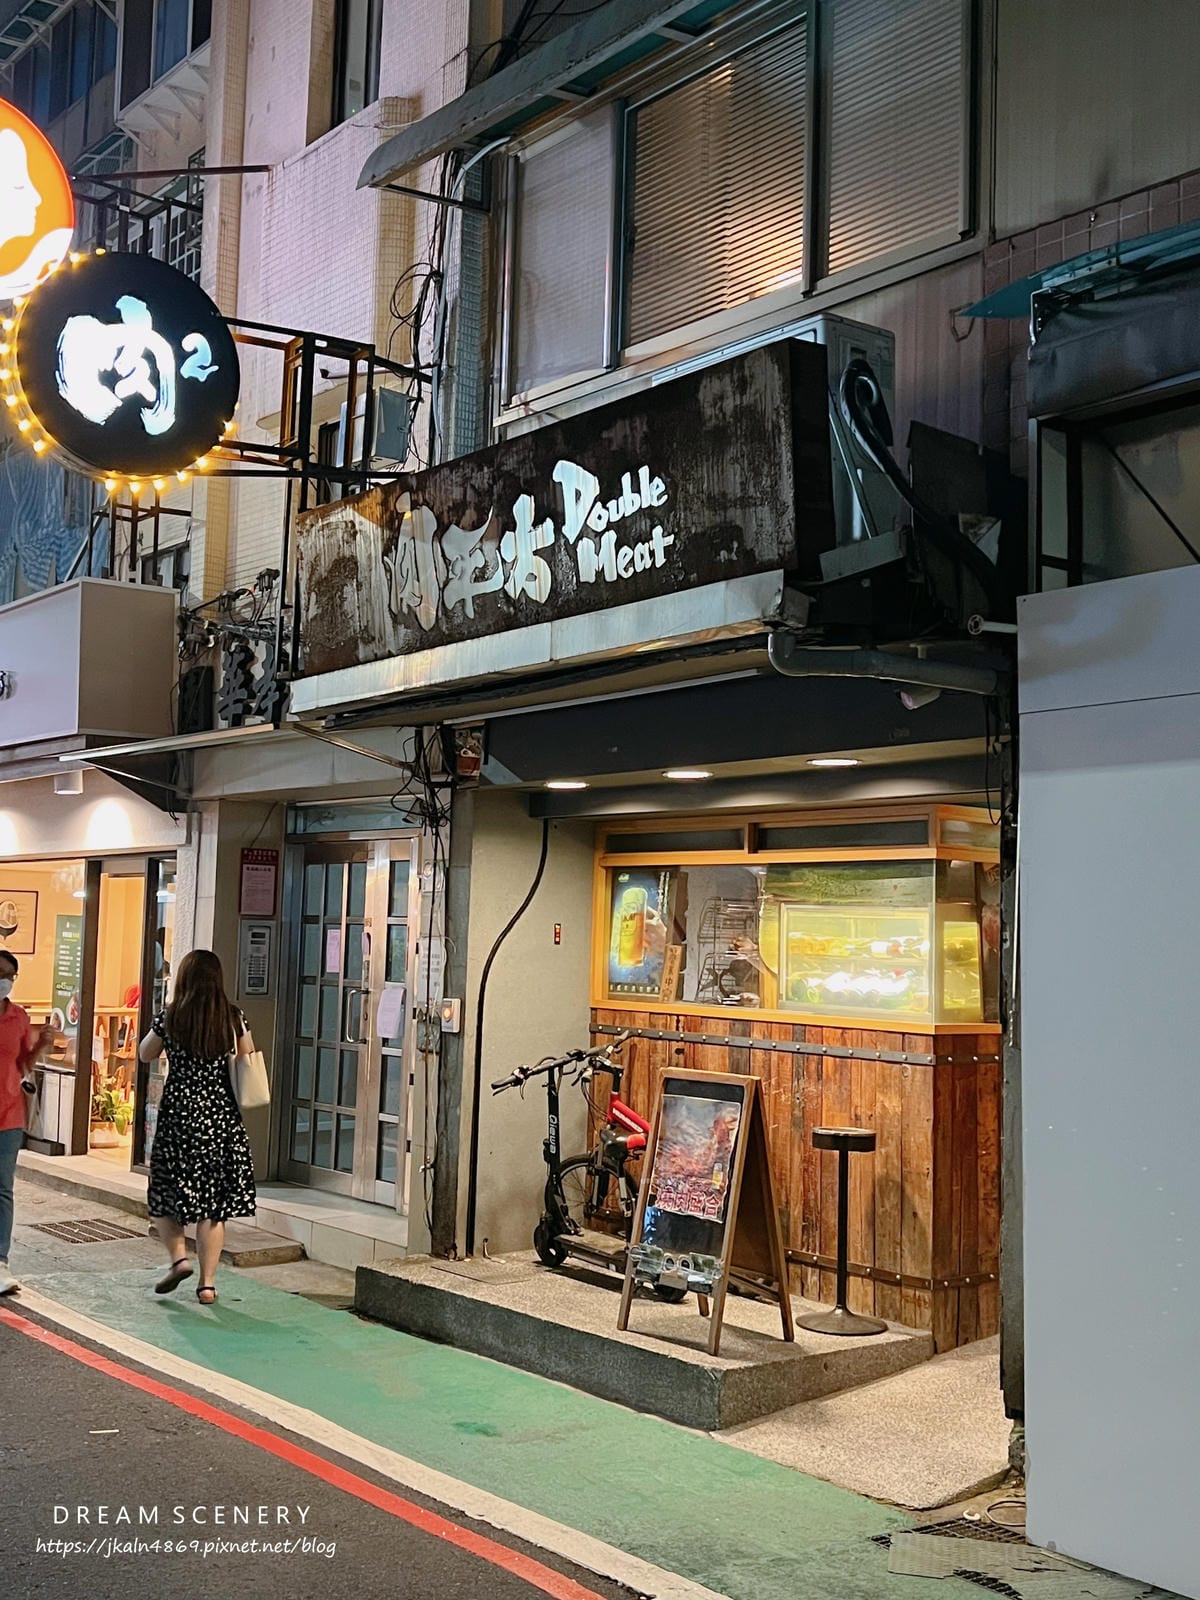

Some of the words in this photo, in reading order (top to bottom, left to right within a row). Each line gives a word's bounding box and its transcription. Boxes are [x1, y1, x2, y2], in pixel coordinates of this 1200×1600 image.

[553, 460, 668, 543] Double
[577, 525, 675, 583] Meat
[549, 1114, 558, 1154] Qiewa
